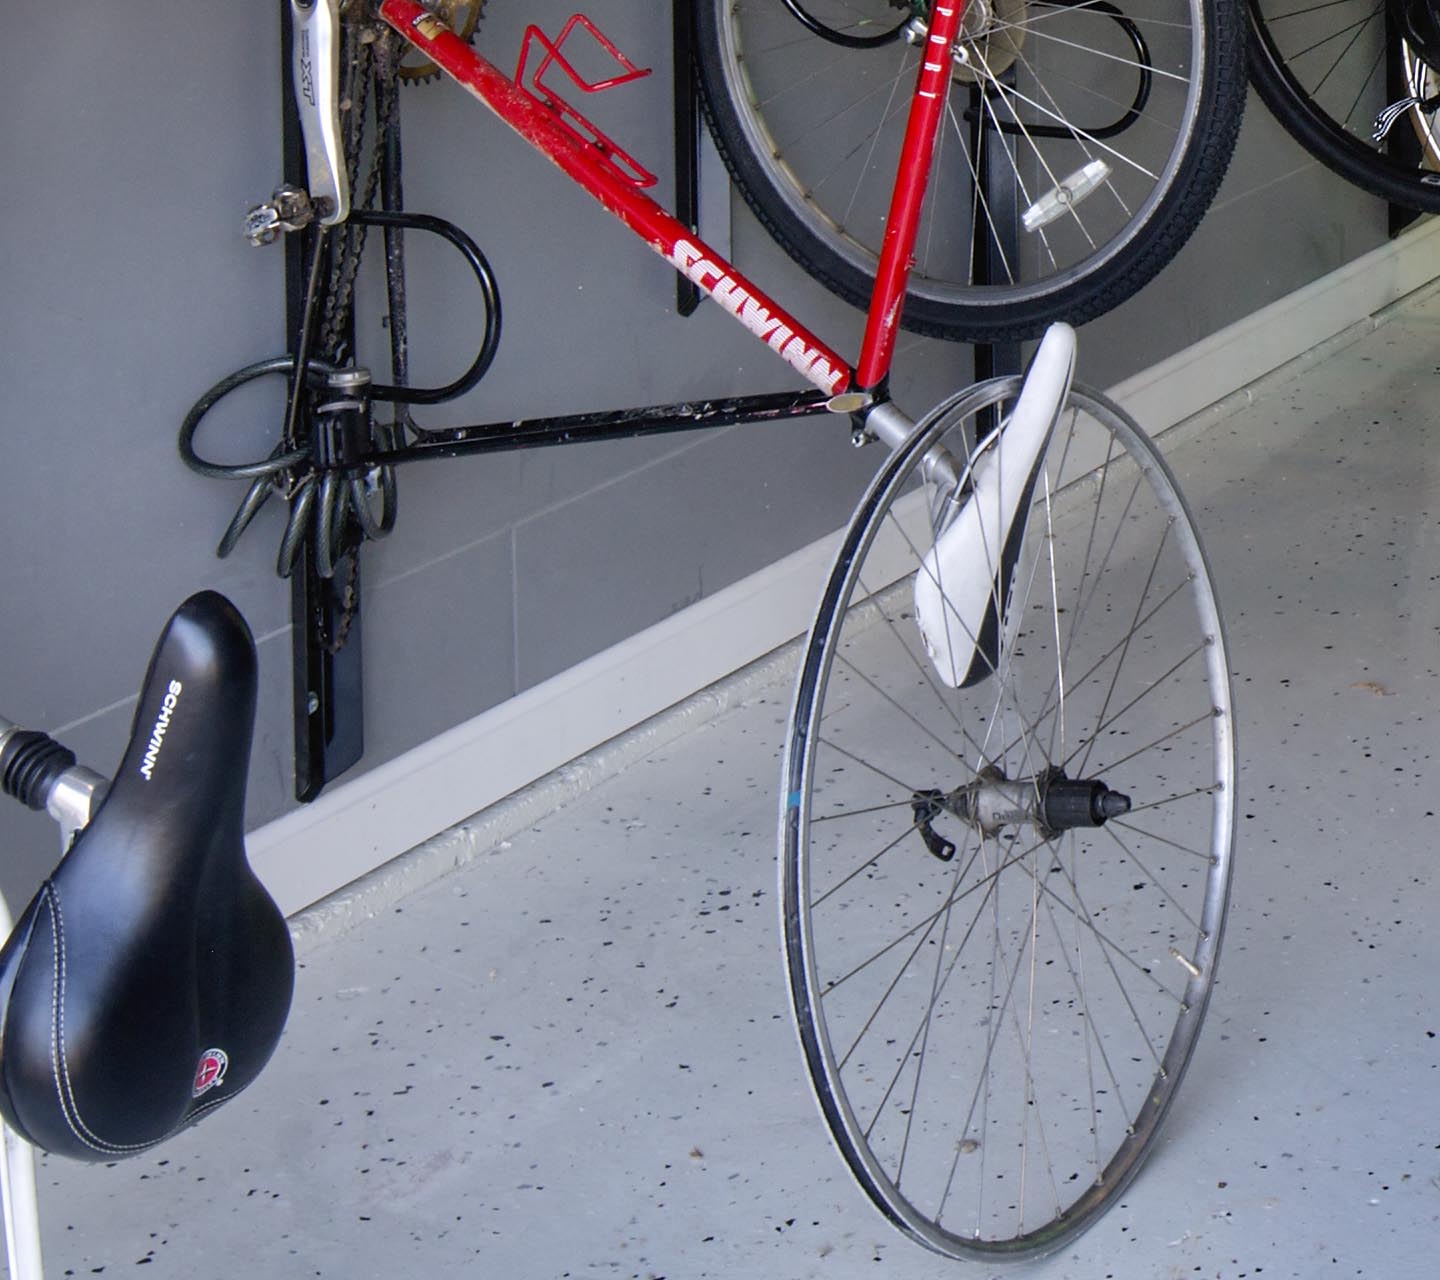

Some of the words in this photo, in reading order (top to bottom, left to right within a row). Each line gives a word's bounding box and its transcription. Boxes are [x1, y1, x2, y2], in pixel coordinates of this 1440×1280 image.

[301, 55, 316, 107] XT
[667, 238, 845, 397] SCHWINN
[140, 679, 183, 781] SCHWINN
